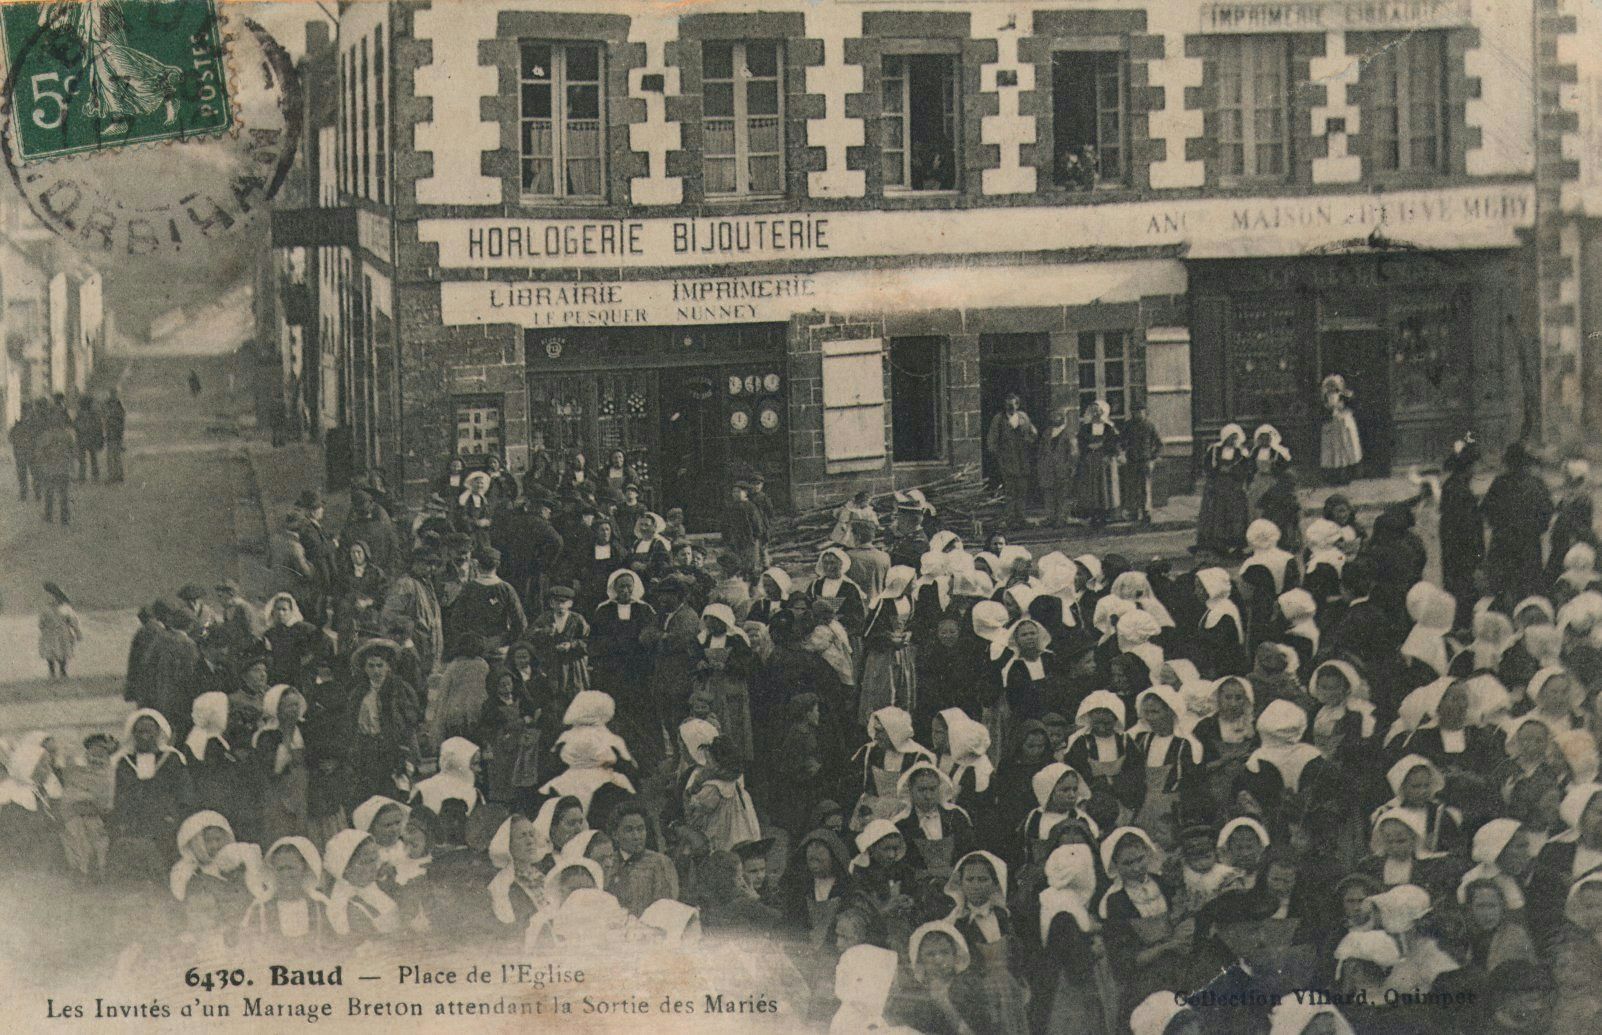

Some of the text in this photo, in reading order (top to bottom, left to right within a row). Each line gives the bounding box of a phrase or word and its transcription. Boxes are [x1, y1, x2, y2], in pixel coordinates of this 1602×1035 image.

[468, 213, 830, 259] HORLOGERIE BIJOUTERIE
[489, 274, 817, 309] LIBRAIRIE IMPRIMERIE
[564, 307, 648, 327] PESQUER
